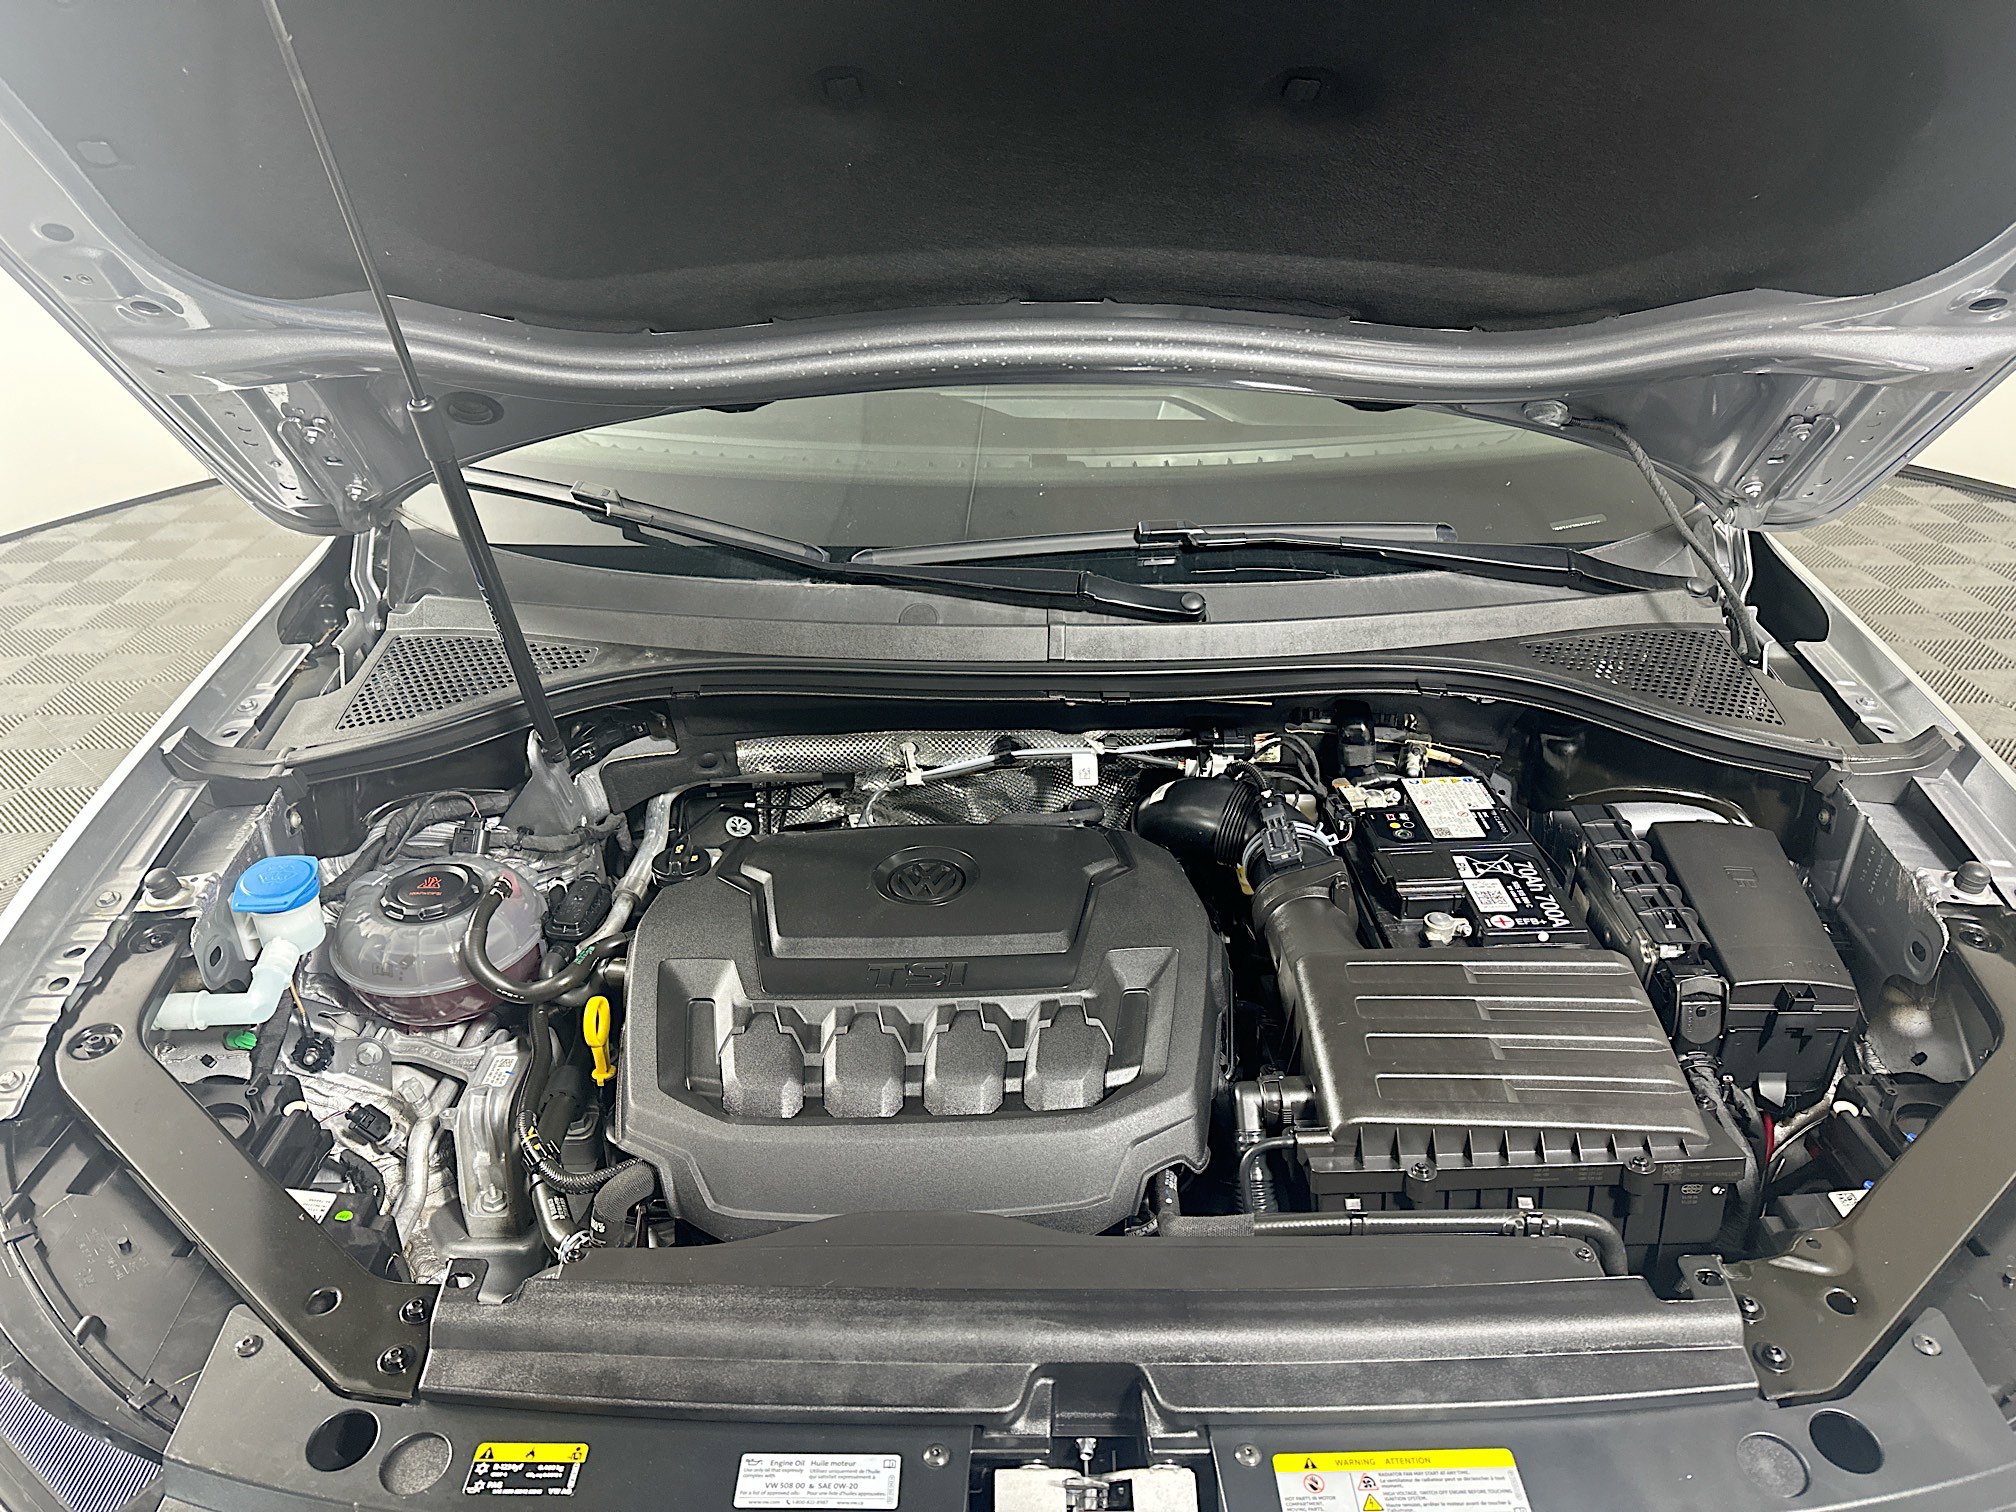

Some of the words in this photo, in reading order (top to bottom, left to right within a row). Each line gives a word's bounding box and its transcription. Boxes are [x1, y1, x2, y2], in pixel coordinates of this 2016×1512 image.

[1513, 860, 1548, 892] 70Ah
[1534, 893, 1570, 928] 700A
[1514, 917, 1548, 925] EFB+
[868, 961, 968, 988] TSI
[770, 1460, 793, 1468] Engine
[1335, 1458, 1376, 1466] WARNING
